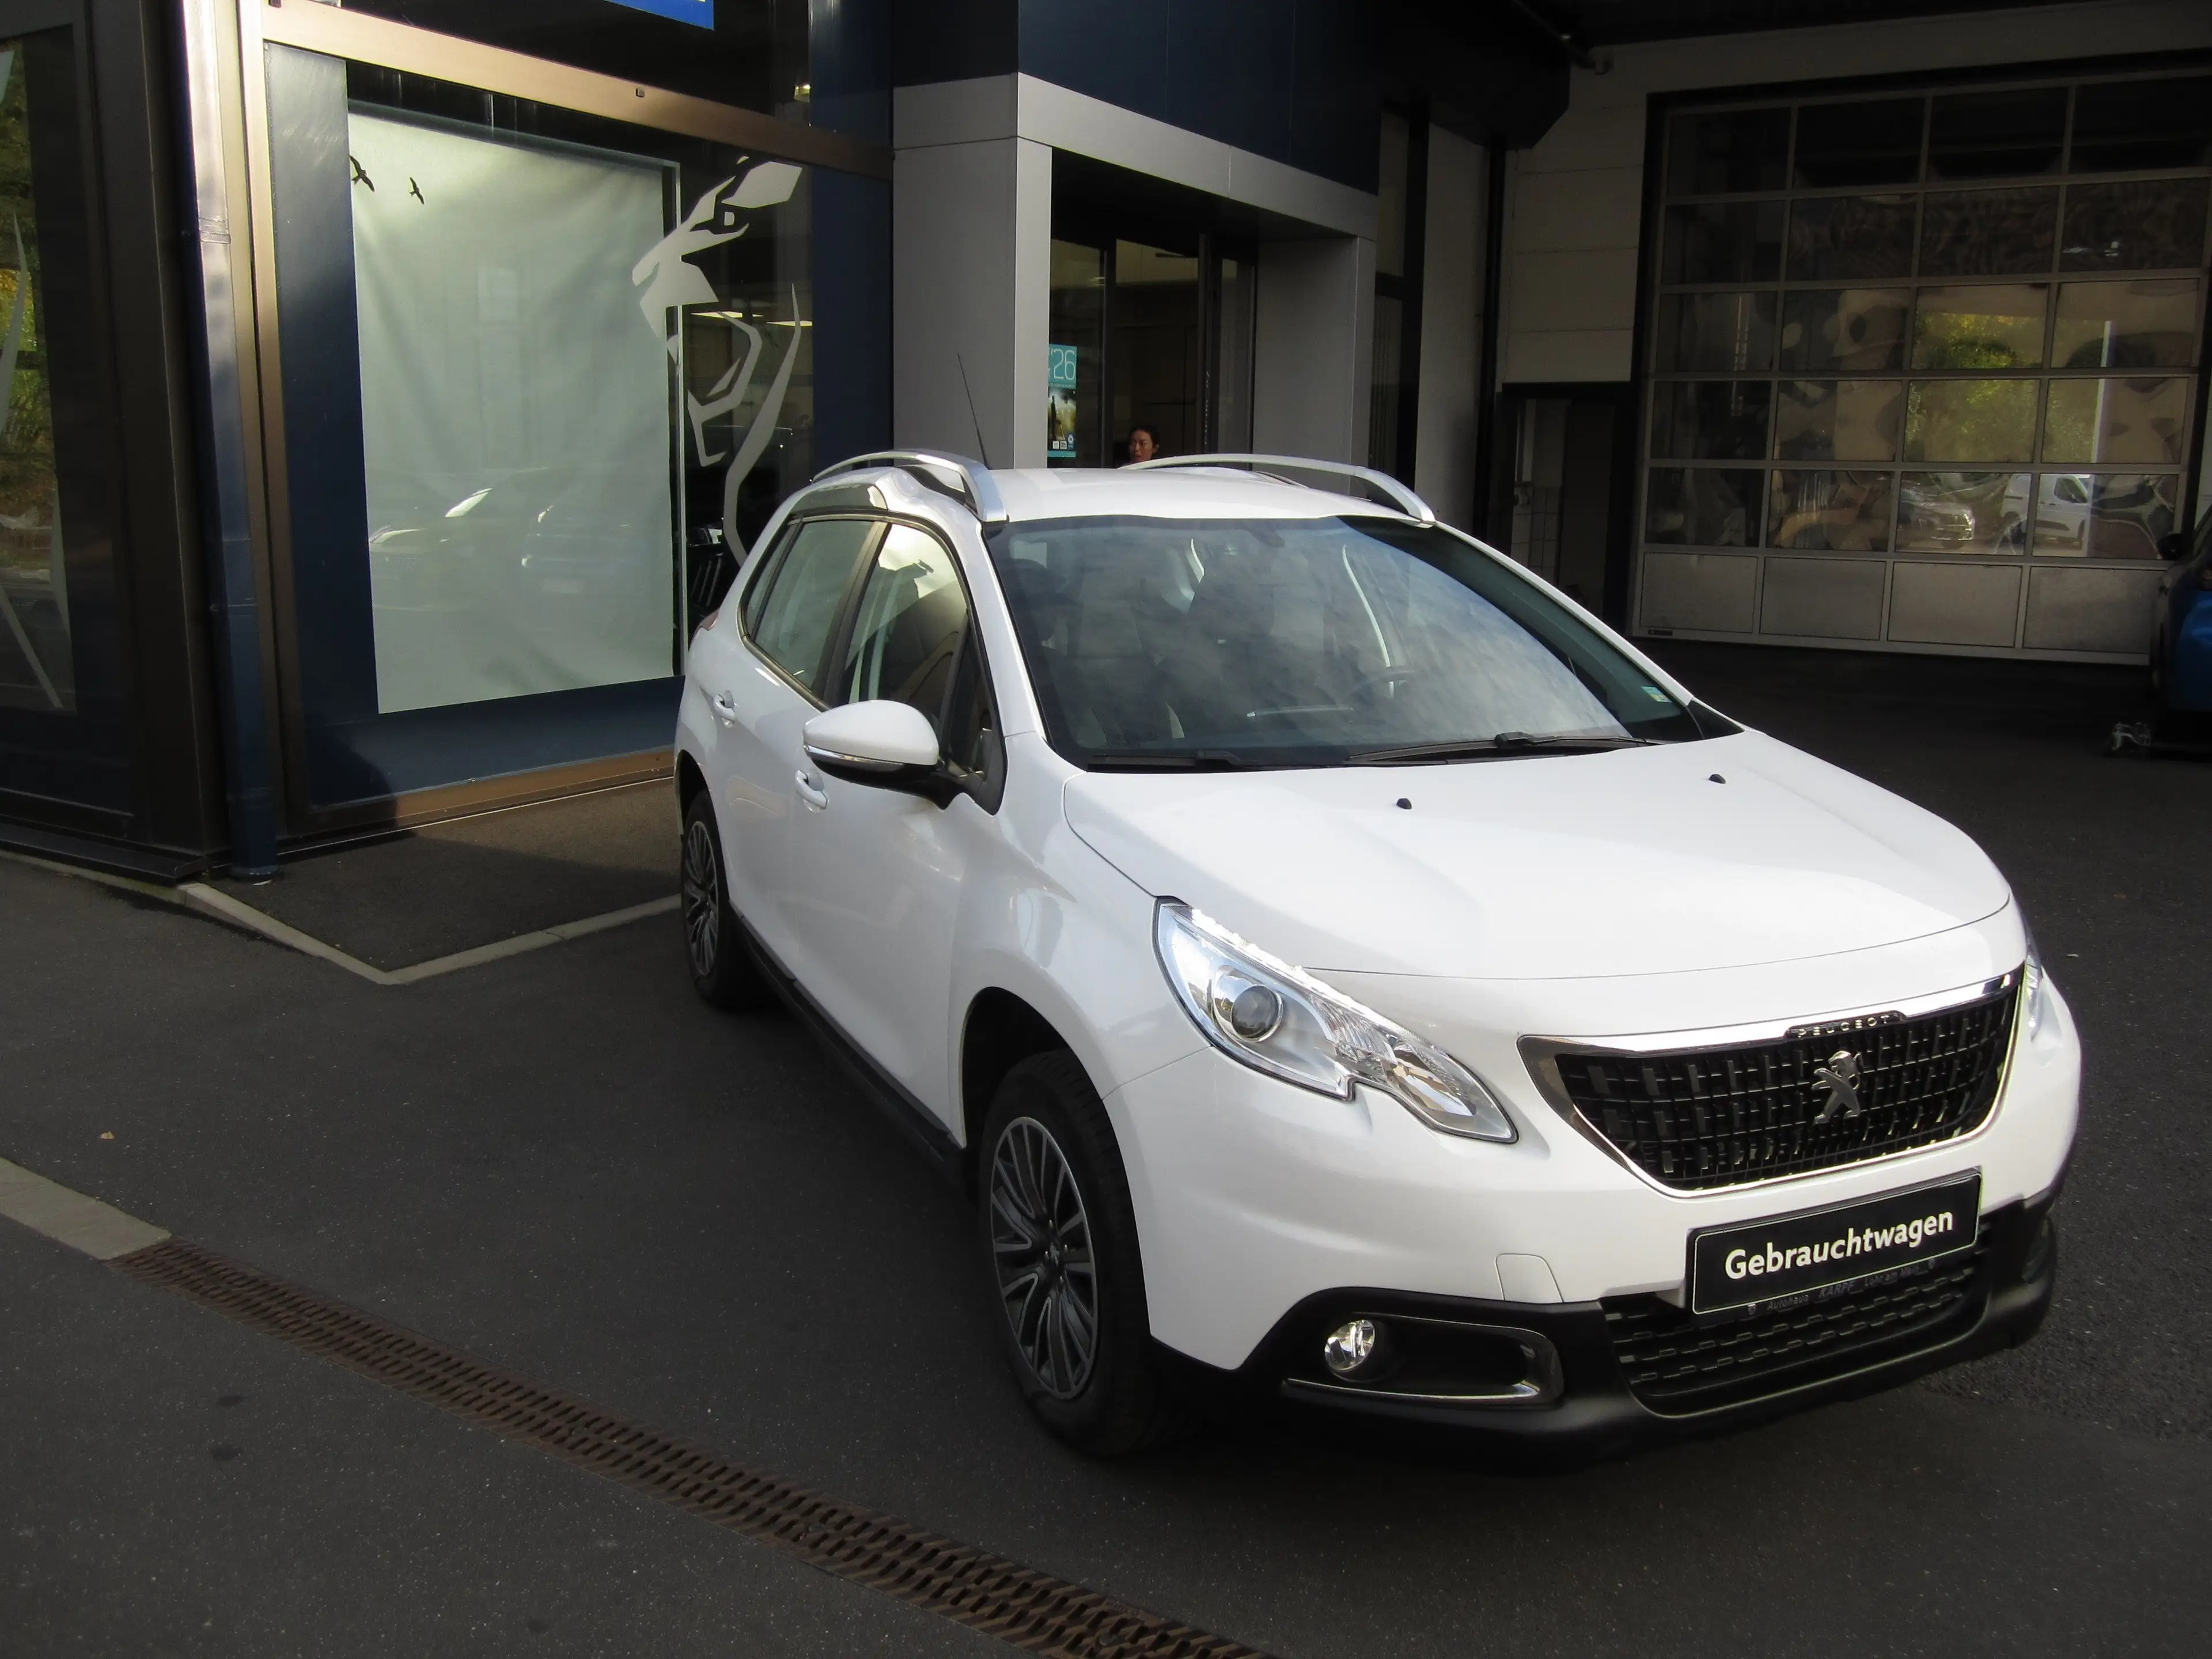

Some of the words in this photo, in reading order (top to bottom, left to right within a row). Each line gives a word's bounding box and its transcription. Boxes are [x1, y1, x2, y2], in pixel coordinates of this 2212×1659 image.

[1797, 1014, 1890, 1038] PEUGEOT
[1724, 1211, 1953, 1280] Gebrauchtwagen
[1767, 1294, 1810, 1311] Autohaus
